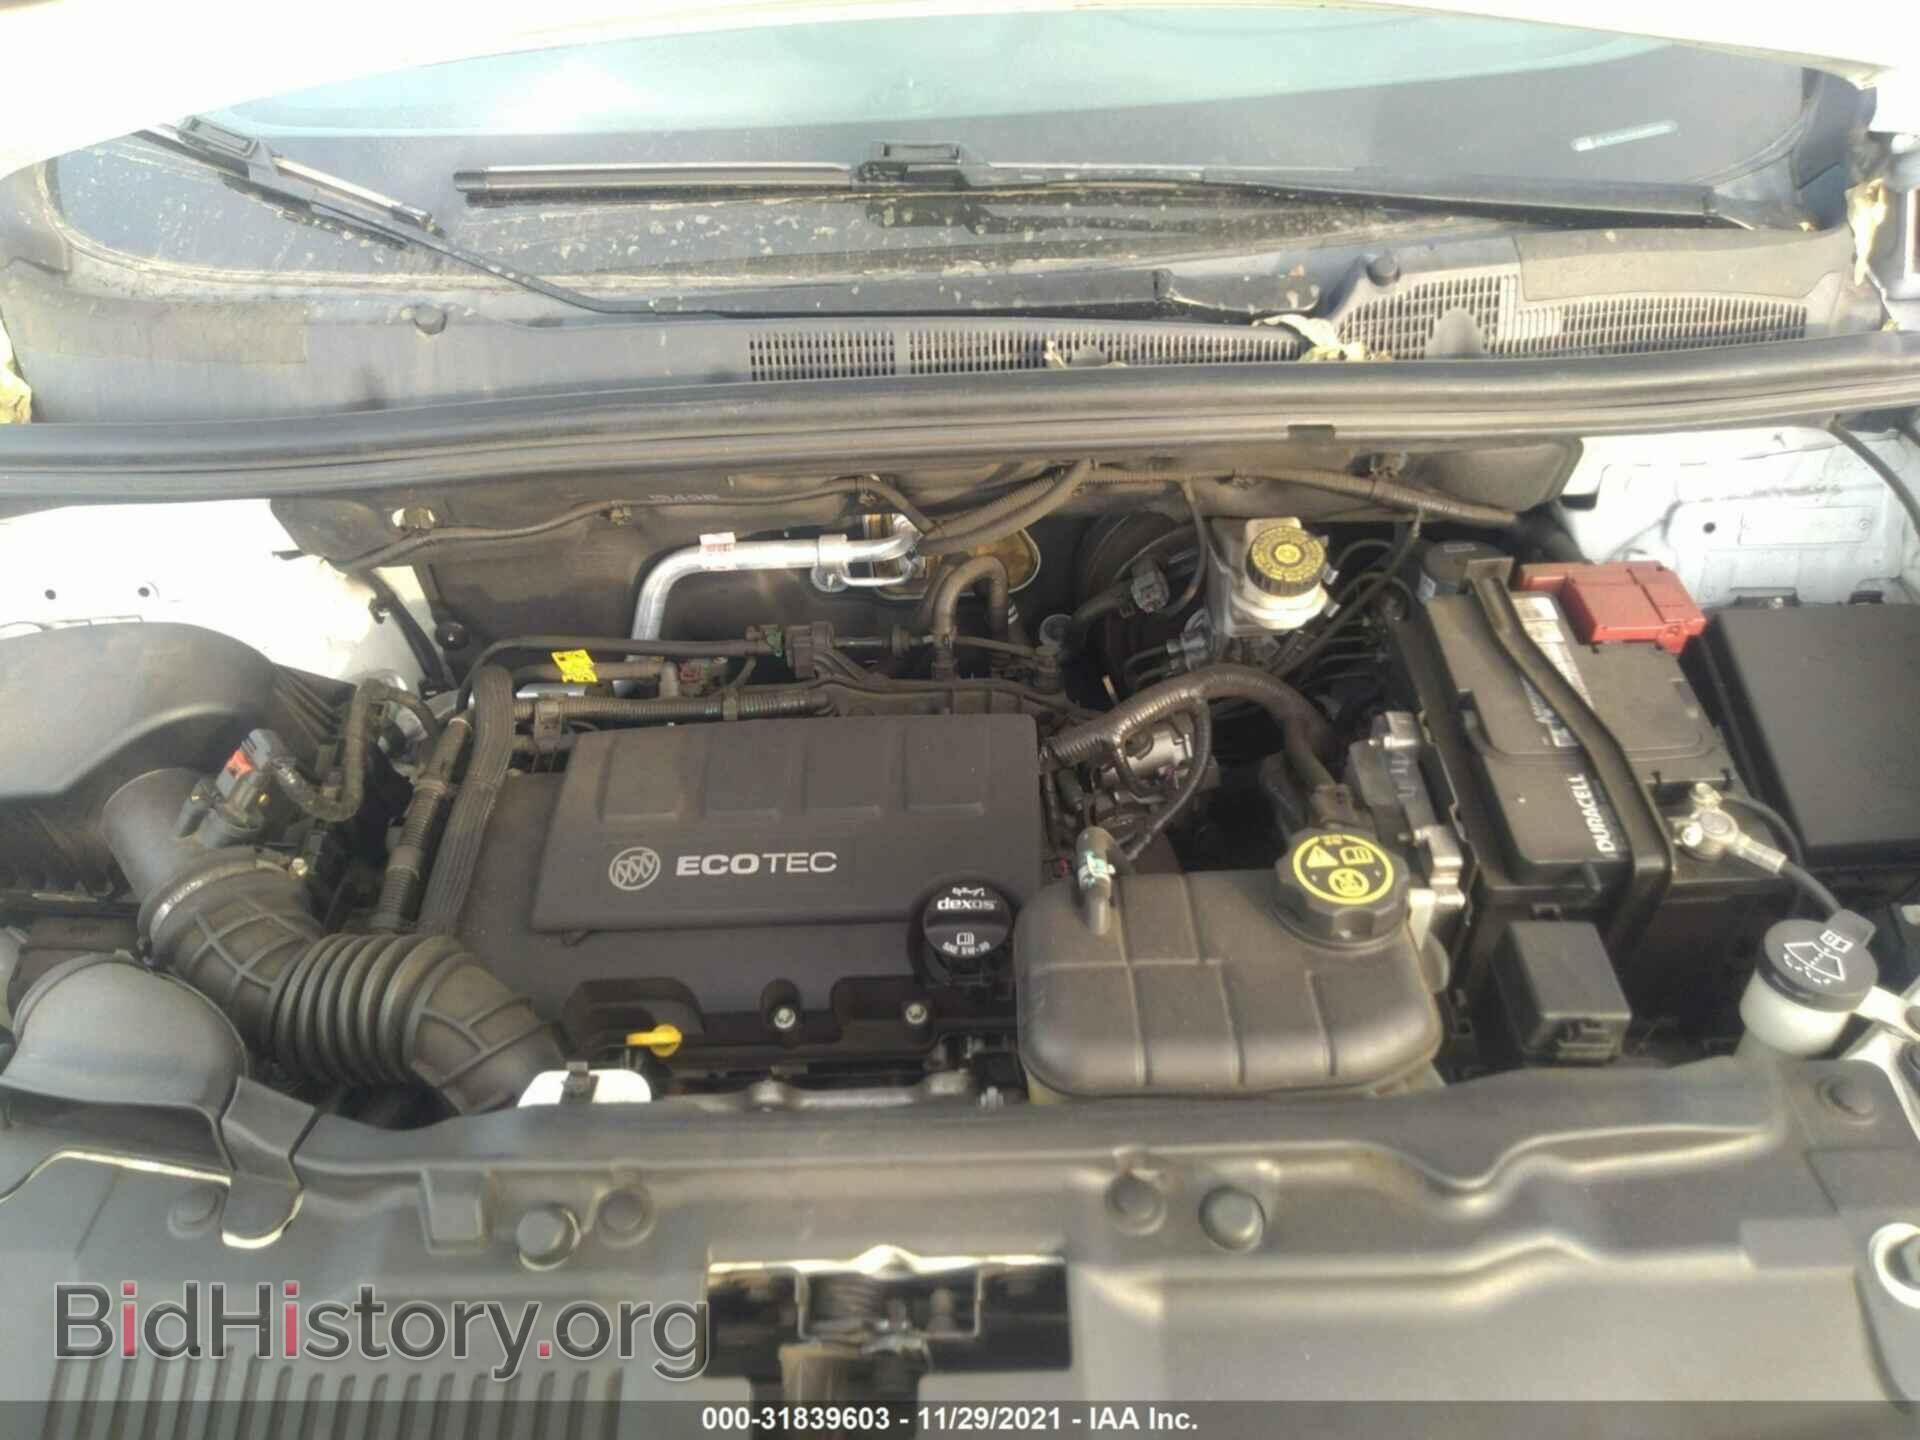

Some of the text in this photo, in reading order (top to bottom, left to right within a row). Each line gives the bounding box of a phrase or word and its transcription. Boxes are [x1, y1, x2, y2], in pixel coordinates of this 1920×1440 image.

[1567, 774, 1617, 852] DURACELL
[676, 851, 837, 876] ECOTEC
[937, 896, 995, 910] dexos
